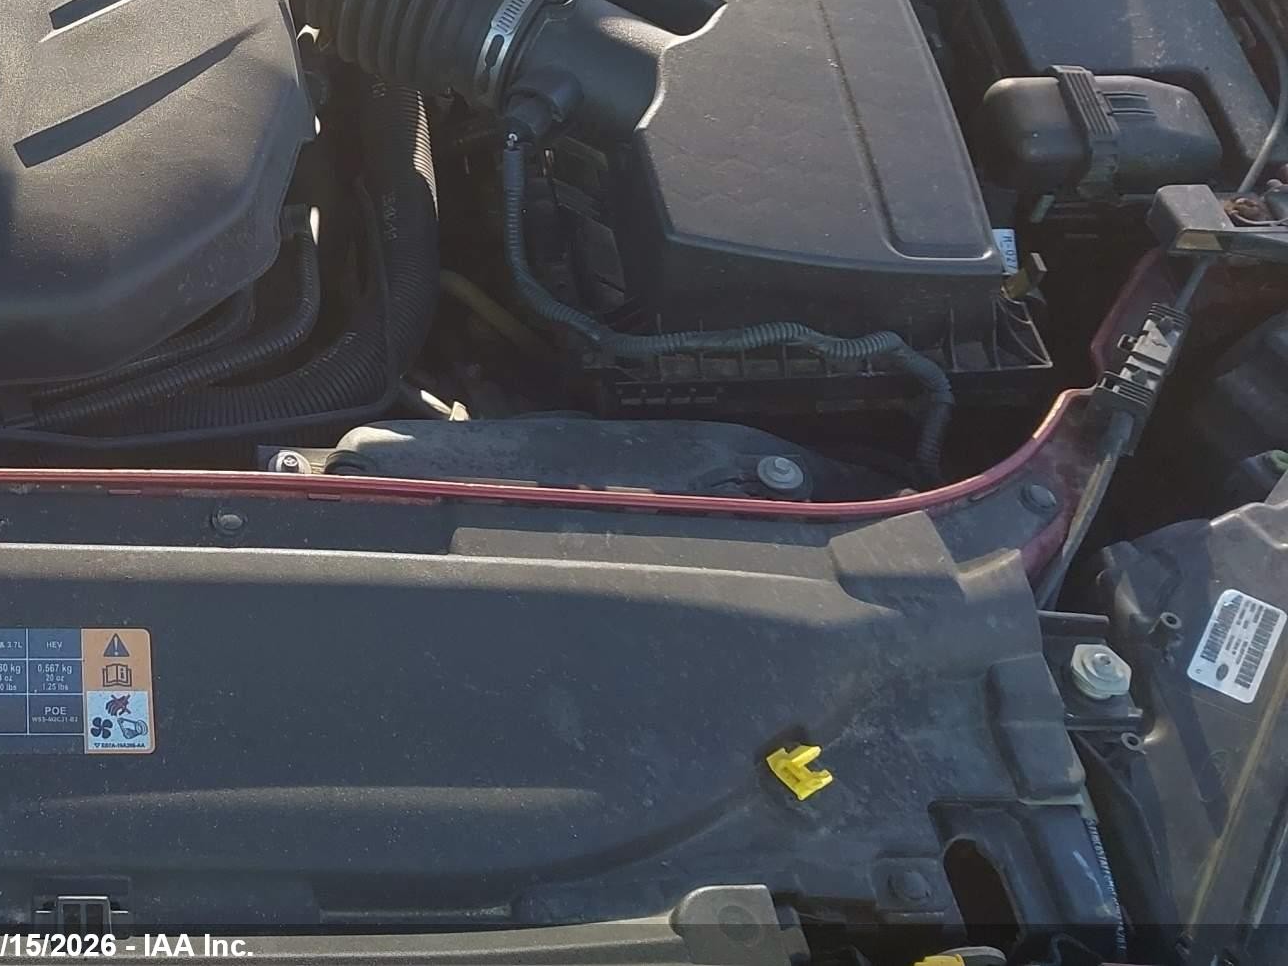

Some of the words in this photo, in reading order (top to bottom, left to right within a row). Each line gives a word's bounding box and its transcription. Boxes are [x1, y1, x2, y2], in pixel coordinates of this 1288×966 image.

[46, 641, 63, 650] HEV
[10, 663, 21, 675] kg
[61, 663, 72, 675] kg
[45, 674, 54, 682] 20
[44, 706, 67, 715] POE
